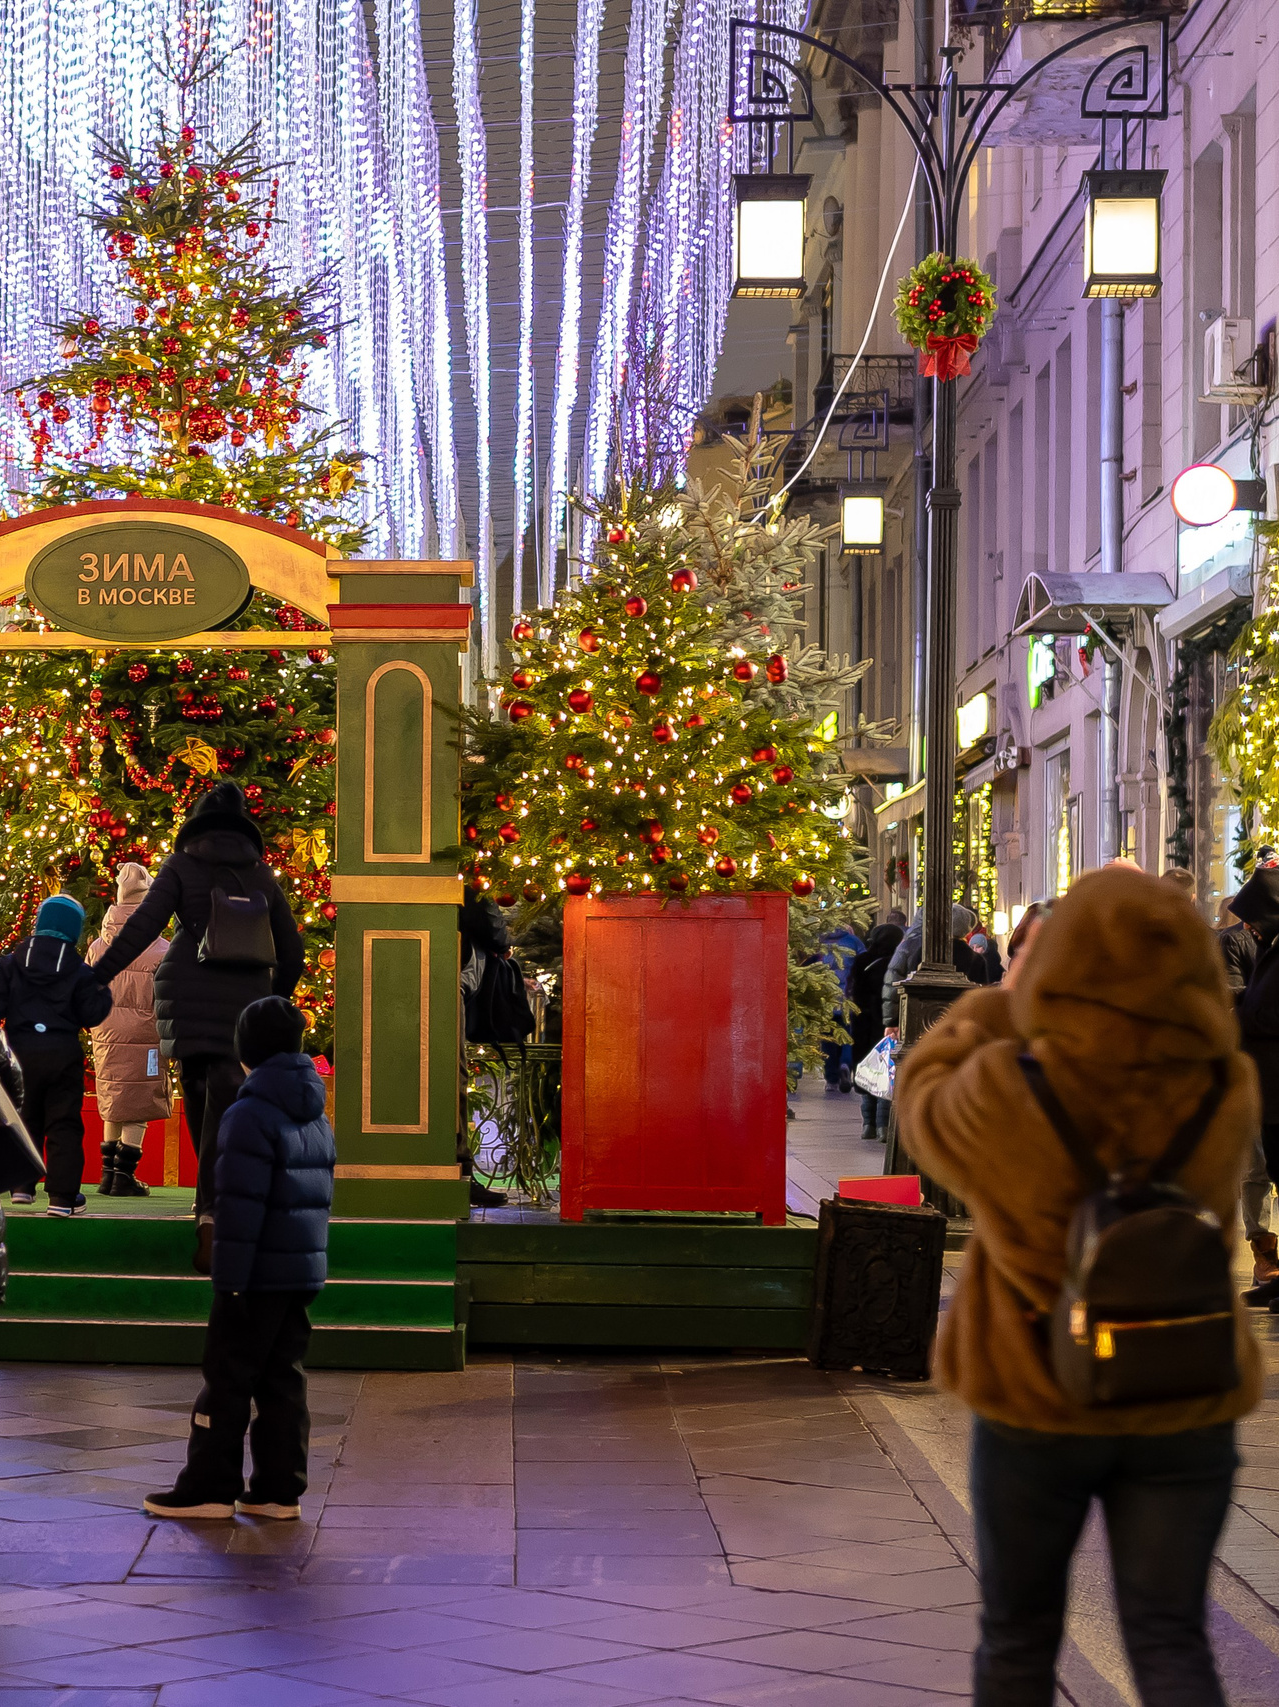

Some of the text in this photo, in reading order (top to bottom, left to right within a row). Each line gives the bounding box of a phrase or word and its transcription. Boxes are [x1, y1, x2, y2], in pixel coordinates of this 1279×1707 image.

[78, 552, 196, 582] ЗИМА
[77, 588, 196, 605] В МОСКВЕ
